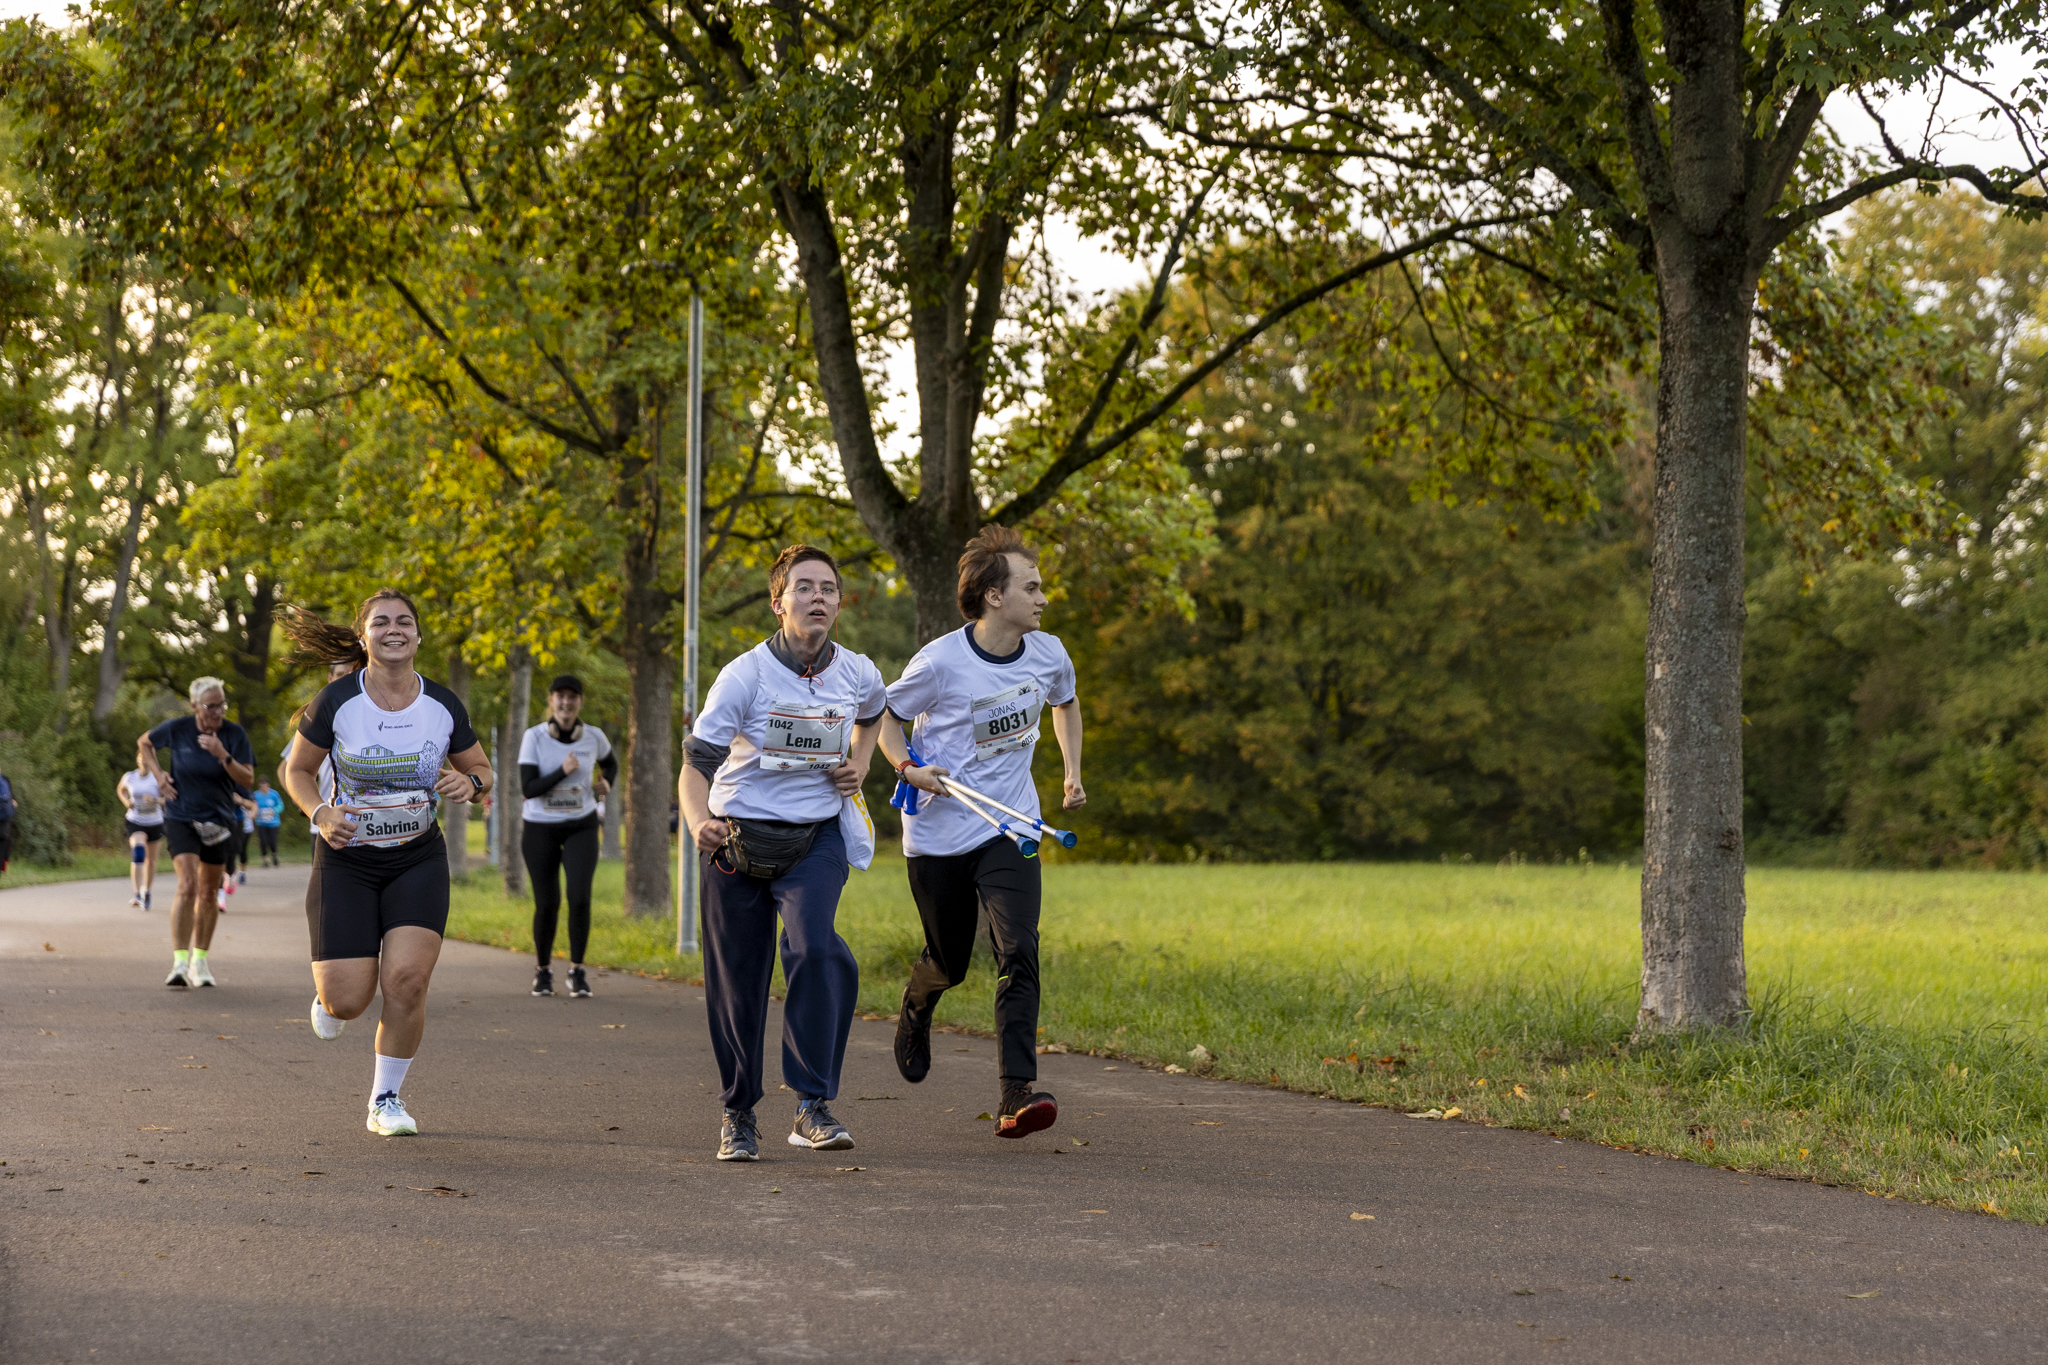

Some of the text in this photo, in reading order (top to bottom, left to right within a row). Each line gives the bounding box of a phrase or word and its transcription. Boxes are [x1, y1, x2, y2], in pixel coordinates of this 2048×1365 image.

[989, 702, 1016, 718] JONAS
[768, 718, 794, 730] 1042
[988, 709, 1028, 735] 8031
[785, 732, 822, 749] Lena
[1021, 733, 1035, 747] 8031
[358, 812, 374, 822] 797
[366, 820, 420, 836] Sabrina
